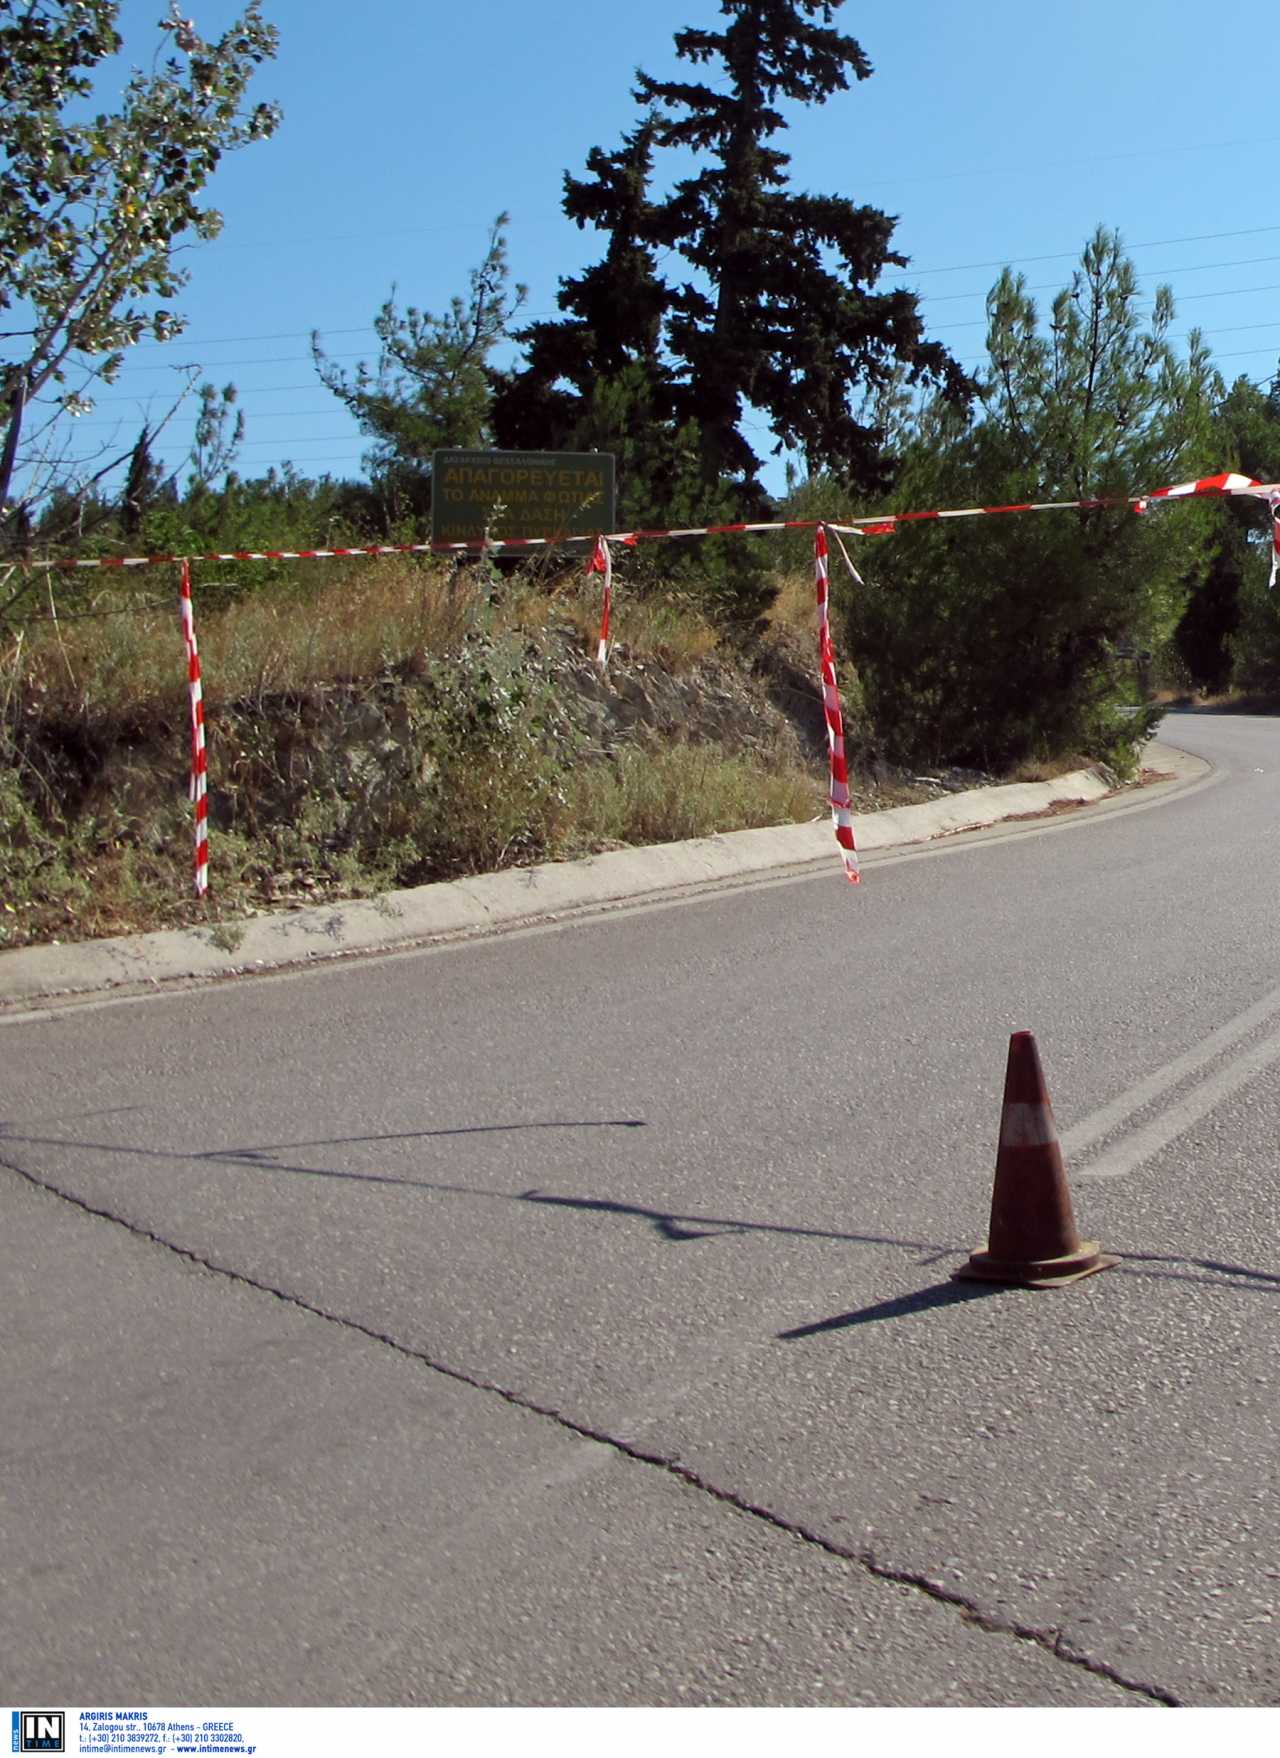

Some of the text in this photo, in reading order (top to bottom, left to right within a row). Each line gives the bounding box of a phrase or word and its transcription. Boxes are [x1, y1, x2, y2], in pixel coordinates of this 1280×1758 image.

[446, 467, 604, 486] ΑΠΑΓΟΡΕΥΕΤΑΙ
[442, 488, 604, 505] ΤΟ ΑΝΑΜΜΑ ΦΩΤΙΣ
[519, 507, 566, 522] ΔΑΣΗ
